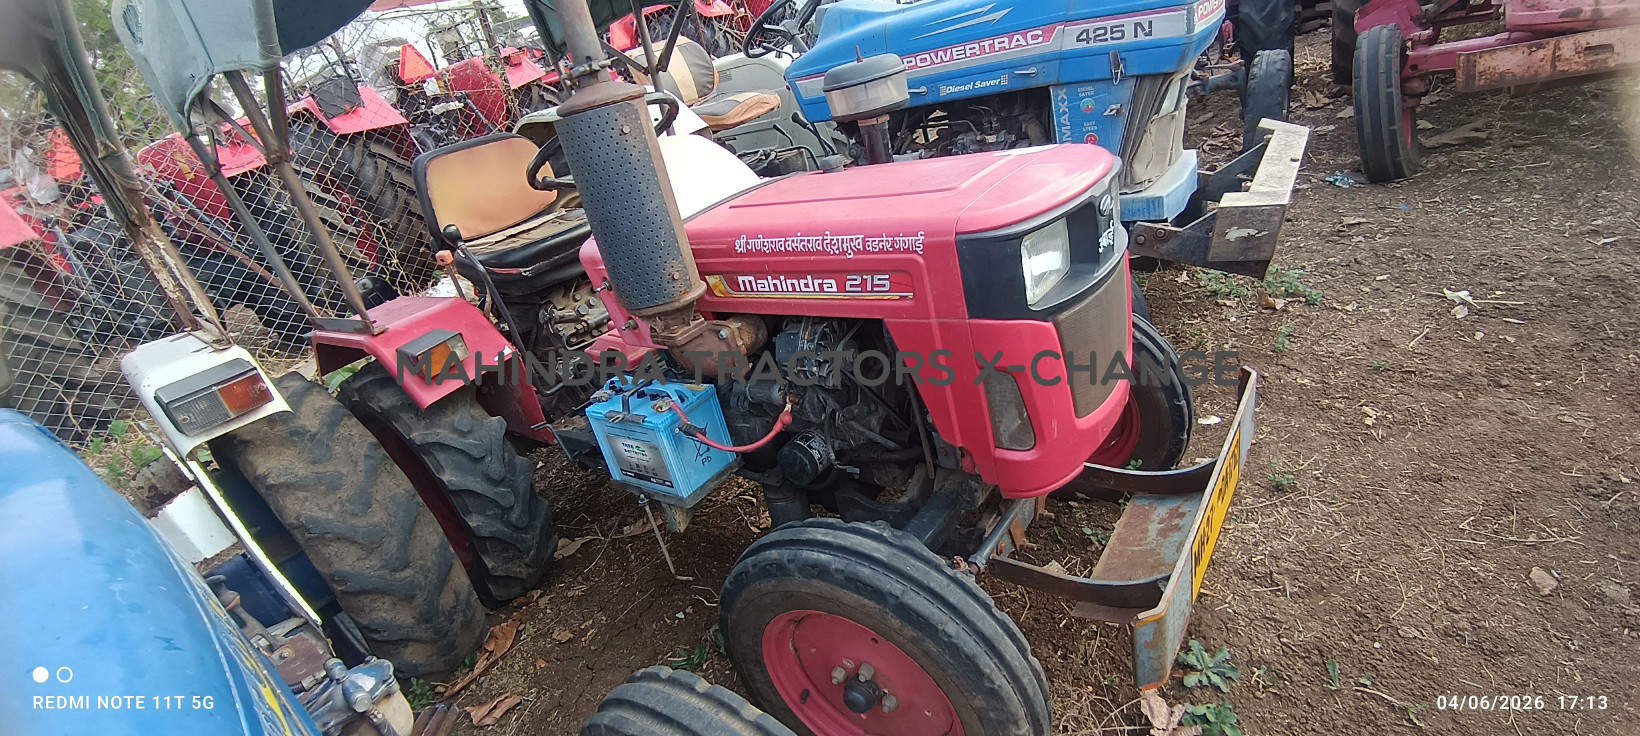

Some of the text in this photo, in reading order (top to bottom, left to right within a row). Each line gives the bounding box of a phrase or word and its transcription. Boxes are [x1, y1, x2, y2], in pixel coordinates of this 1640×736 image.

[902, 20, 1153, 70] POWERTRAC 425 N
[946, 78, 1001, 94] Diesel Saver
[734, 235, 747, 254] श्री
[747, 234, 785, 254] गणेशराव
[785, 232, 823, 252] वसंतराव
[824, 231, 864, 259] देशमुख
[738, 275, 891, 293] Mahindra 215
[700, 456, 712, 467] Pb
